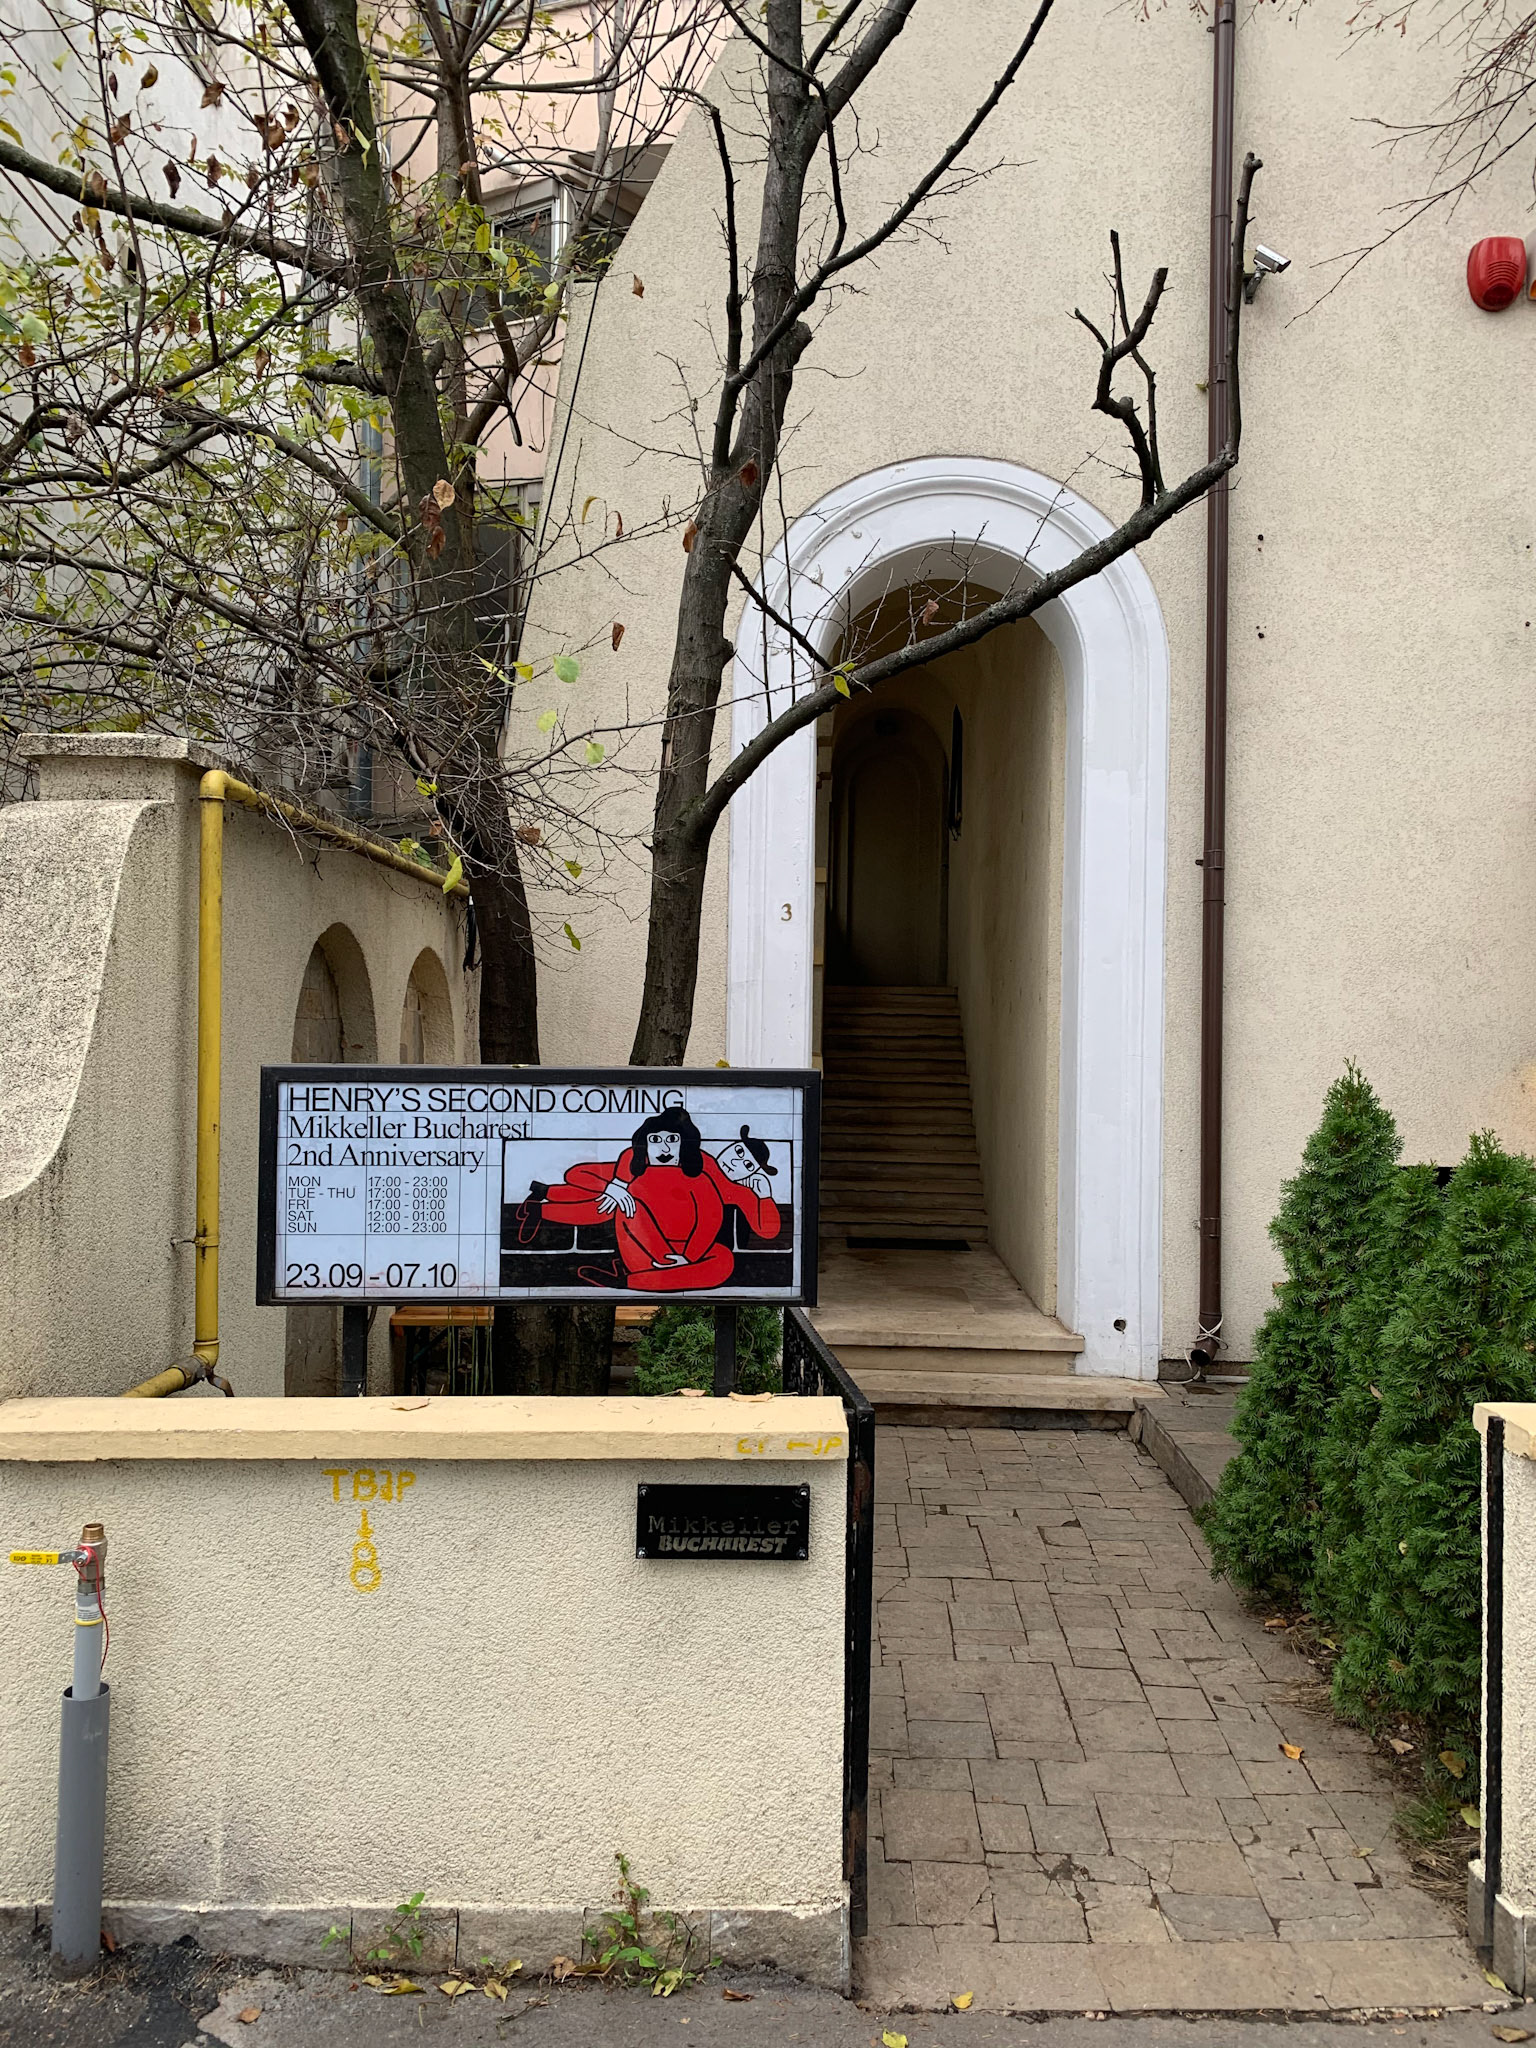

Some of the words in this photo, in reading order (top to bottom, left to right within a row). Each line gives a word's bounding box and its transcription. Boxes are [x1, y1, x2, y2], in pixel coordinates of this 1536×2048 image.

[780, 902, 793, 922] 3
[427, 1087, 556, 1113] SECOND
[562, 1088, 685, 1113] COMING
[287, 1115, 407, 1139] Mikkeller
[412, 1116, 531, 1139] Bucharest
[287, 1143, 333, 1167] 2nd
[338, 1142, 485, 1174] Anniversary
[288, 1176, 321, 1187] MON
[368, 1176, 401, 1187] 17:00
[412, 1176, 448, 1187] 23:00
[288, 1187, 316, 1199] TUE
[327, 1187, 356, 1199] THU
[368, 1187, 401, 1199] 17:00
[412, 1187, 448, 1199] 00:00
[288, 1199, 310, 1210] FRI
[368, 1199, 401, 1210] 17:00
[412, 1199, 446, 1210] 01:00
[287, 1210, 315, 1222] SAT
[367, 1210, 401, 1222] 12:00
[412, 1210, 445, 1222] 01:00
[287, 1222, 318, 1233] SUN
[367, 1222, 401, 1233] 12:00
[411, 1222, 447, 1233] 23:00
[286, 1263, 363, 1288] 23.09
[386, 1263, 457, 1288] 07.10
[648, 1515, 800, 1535] Mikkeller
[658, 1535, 788, 1554] BUCHAREST
